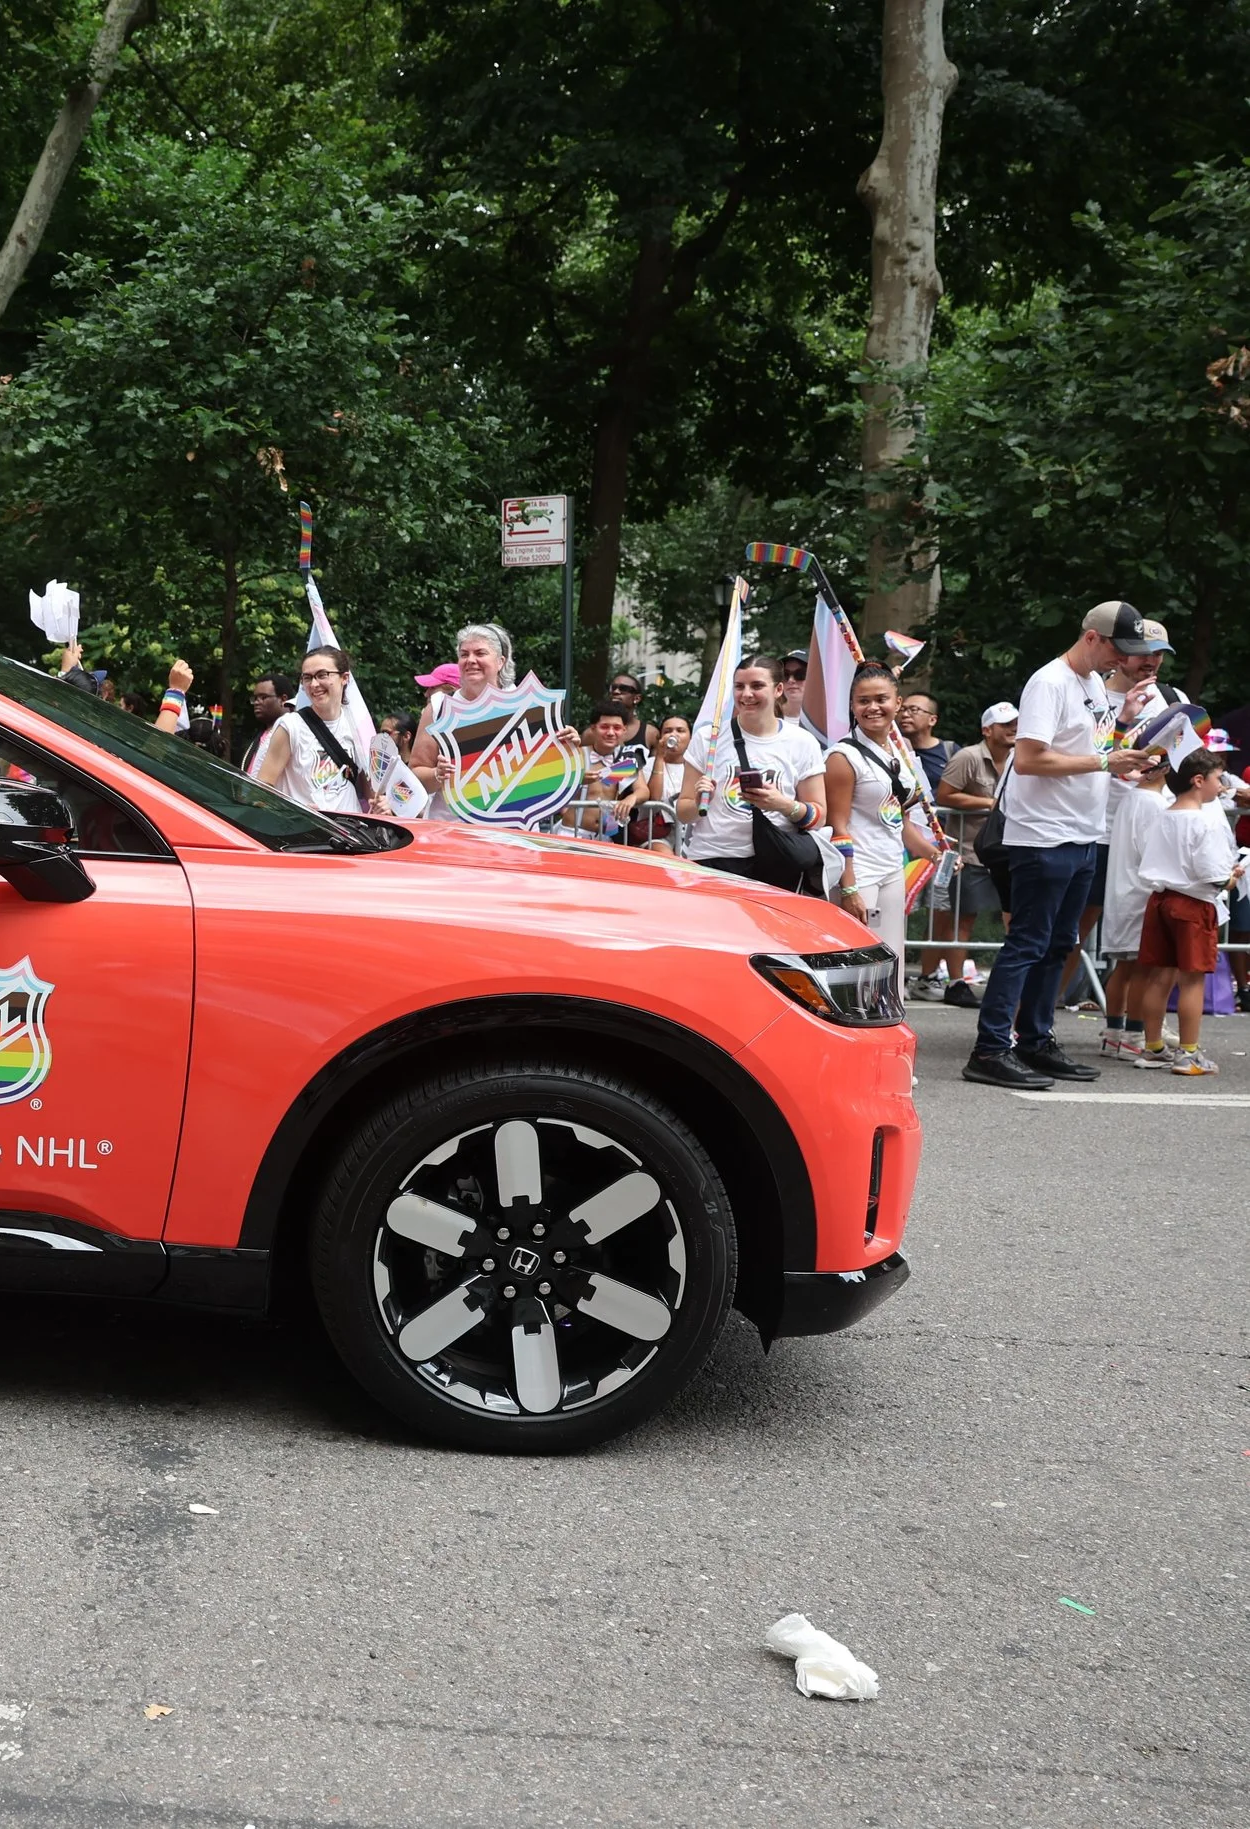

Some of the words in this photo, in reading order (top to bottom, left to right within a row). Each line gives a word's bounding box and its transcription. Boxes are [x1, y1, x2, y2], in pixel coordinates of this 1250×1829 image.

[515, 547, 534, 555] Engine
[535, 546, 551, 554] Idling
[531, 554, 550, 562] $2000
[475, 718, 544, 806] NHL
